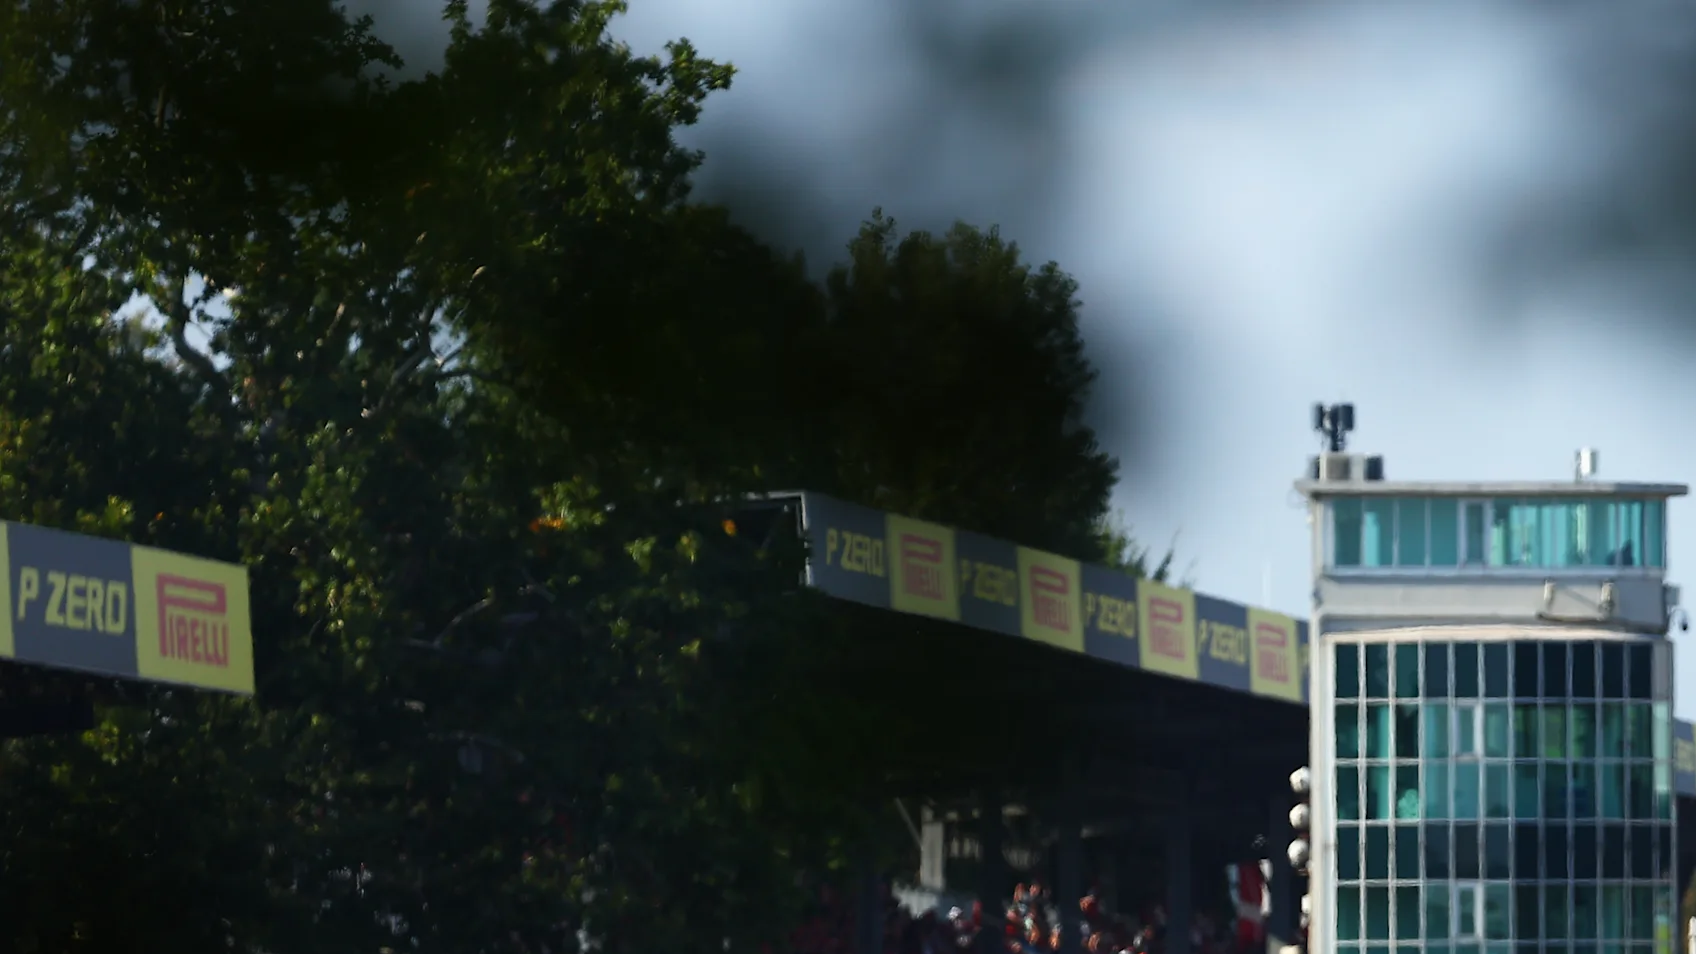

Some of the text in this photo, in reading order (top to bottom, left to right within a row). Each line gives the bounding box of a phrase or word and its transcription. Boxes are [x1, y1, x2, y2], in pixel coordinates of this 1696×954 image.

[826, 528, 885, 577] P ZERO
[18, 567, 127, 636] P ZERO
[156, 573, 229, 668] PIRELLI
